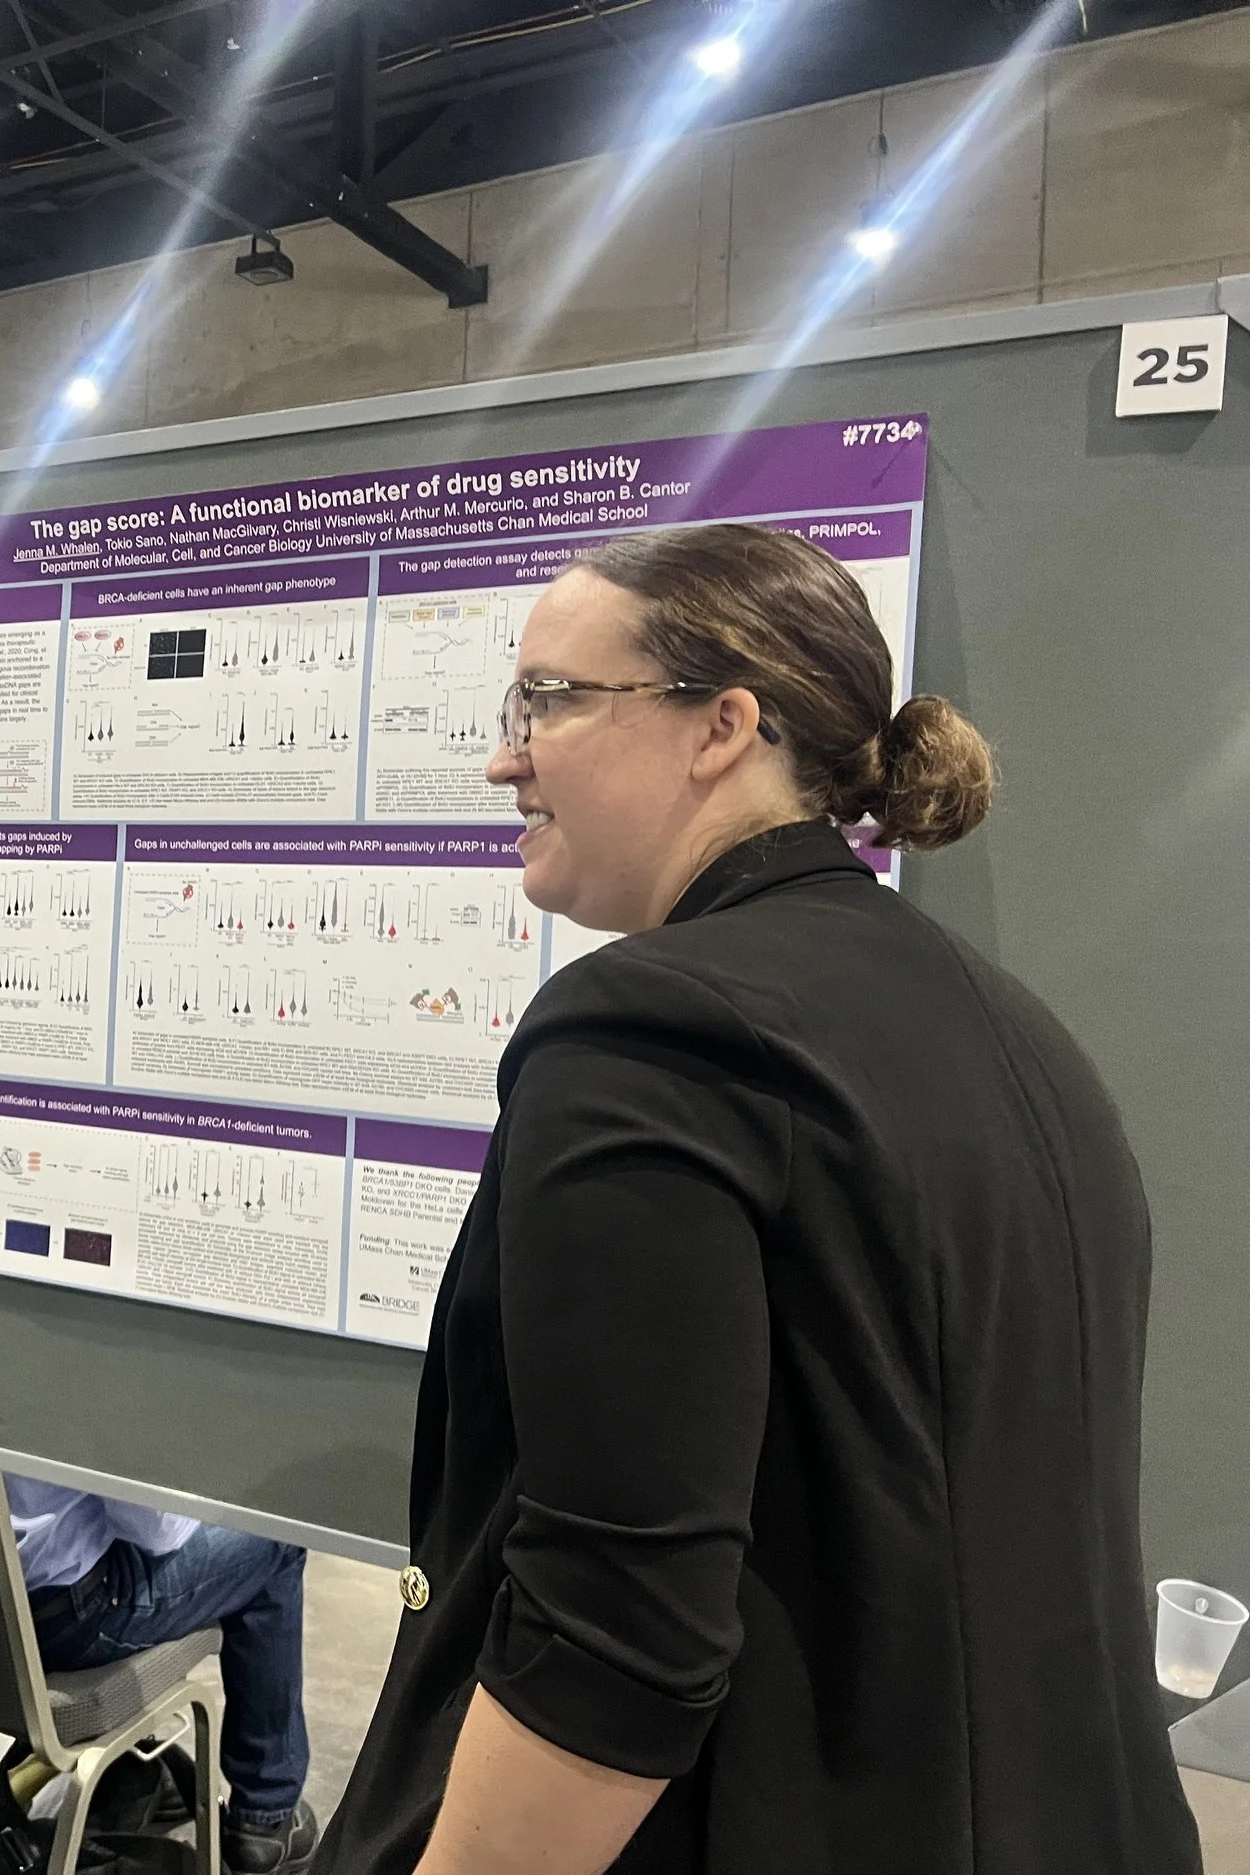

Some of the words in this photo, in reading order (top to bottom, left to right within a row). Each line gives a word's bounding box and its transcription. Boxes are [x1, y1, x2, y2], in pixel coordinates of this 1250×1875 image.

[1133, 344, 1209, 387] 25
[843, 420, 915, 446] #7734
[30, 517, 63, 539] The
[68, 517, 102, 540] gap
[107, 509, 164, 531] score:
[170, 503, 186, 524] A
[189, 491, 291, 522] functional
[297, 481, 410, 511] biomarker
[416, 475, 440, 498] of
[446, 473, 502, 496] drug
[510, 455, 640, 488] sensitivity
[13, 547, 44, 559] Jenna
[45, 543, 58, 556] M.
[104, 536, 133, 550] Tokio
[135, 534, 167, 547] Sano,
[169, 529, 210, 544] Nathan
[212, 523, 279, 539] MacGilvary,
[281, 516, 323, 533] Christi
[323, 509, 397, 528] Wisniewski,
[399, 505, 440, 521] Arthur
[443, 502, 460, 516] M.
[464, 496, 528, 515] Mercurio,
[532, 492, 559, 508] and
[563, 490, 615, 505] Sharon
[619, 485, 634, 500] B.
[639, 480, 692, 498] Cantor
[810, 522, 881, 538] PRIMPOL,
[40, 556, 99, 574] Department
[101, 554, 113, 567] of
[114, 550, 169, 566] Molecular,
[171, 546, 196, 561] Cell,
[199, 544, 221, 558] and
[223, 542, 266, 555] Cancer
[268, 537, 313, 552] Biology
[315, 529, 378, 547] University
[379, 527, 393, 541] of
[395, 518, 494, 539] Massachusetts
[497, 516, 534, 530] Chan
[538, 508, 593, 526] Medical
[597, 503, 649, 521] School
[398, 560, 418, 572] The
[420, 561, 441, 573] gap
[443, 555, 492, 568] detection
[495, 553, 528, 565] assay
[530, 547, 571, 561] detects
[515, 566, 537, 578] and
[98, 589, 163, 604] BRCA-deficient
[165, 588, 185, 598] cells
[187, 587, 209, 597] have
[211, 587, 223, 595] an
[225, 581, 262, 594] inherent
[265, 582, 283, 593] gap
[285, 577, 335, 591] phenotype
[7, 833, 27, 843] gaps
[28, 831, 60, 841] induced
[61, 832, 72, 843] by
[25, 844, 34, 855] by
[36, 844, 62, 853] PARPi
[134, 839, 158, 851] Gaps
[159, 839, 168, 849] in
[169, 839, 230, 852] unchallenged
[231, 840, 252, 850] cells
[254, 842, 270, 850] are
[272, 840, 324, 850] associated
[326, 840, 347, 850] with
[349, 840, 382, 850] PARPi
[384, 841, 435, 854] sensitivity
[437, 841, 445, 851] if
[447, 841, 485, 852] PARP1
[488, 842, 498, 852] is
[38, 1098, 46, 1108] is
[47, 1101, 91, 1113] associated
[92, 1105, 111, 1115] with
[112, 1106, 140, 1119] PARPi
[141, 1112, 185, 1127] sensitivity
[186, 1114, 195, 1125] in
[197, 1116, 274, 1134] BRCA1-deficient
[276, 1124, 312, 1138] tumors.
[456, 1178, 480, 1187] peop
